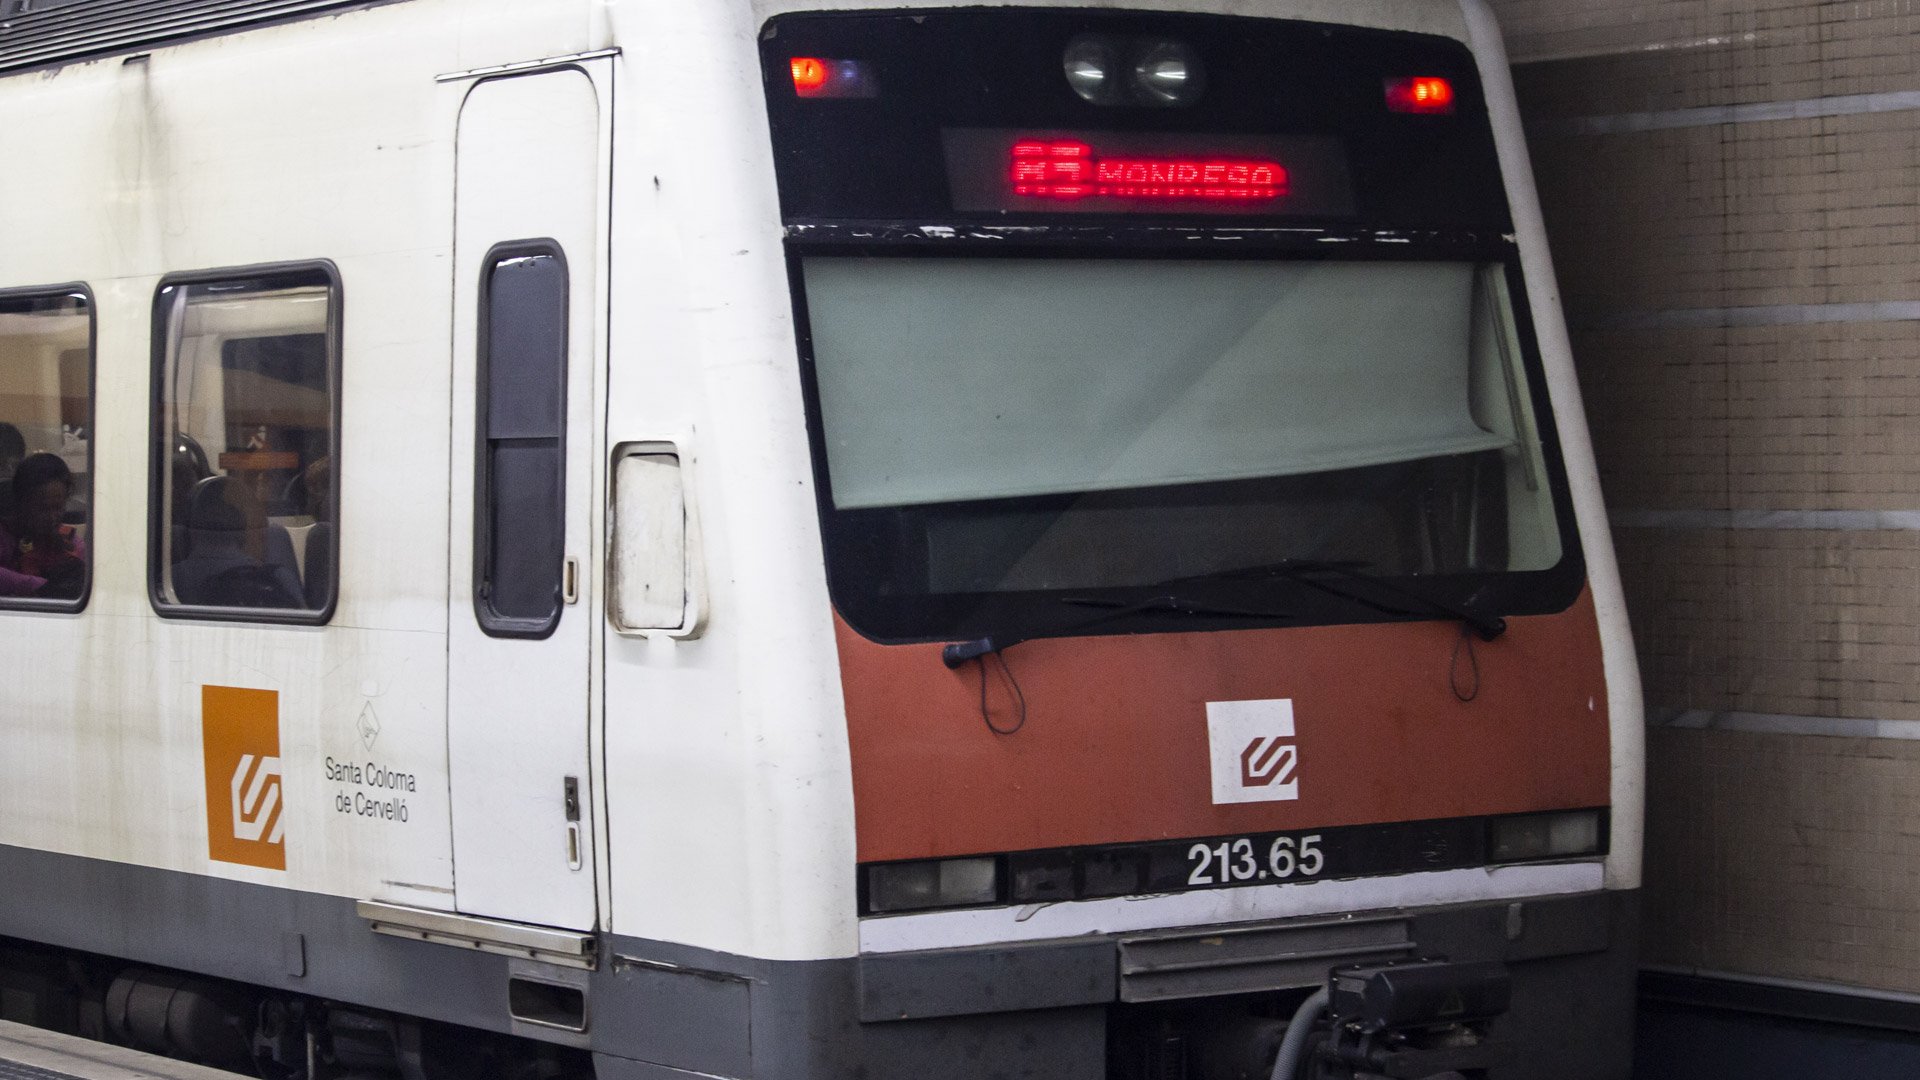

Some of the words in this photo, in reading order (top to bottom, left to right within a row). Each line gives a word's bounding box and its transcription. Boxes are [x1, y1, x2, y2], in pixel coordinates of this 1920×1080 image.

[325, 756, 363, 785] Santa
[365, 762, 417, 793] Coloma
[335, 789, 352, 814] de
[355, 791, 409, 823] Cervelló
[1187, 834, 1325, 886] 213.65
